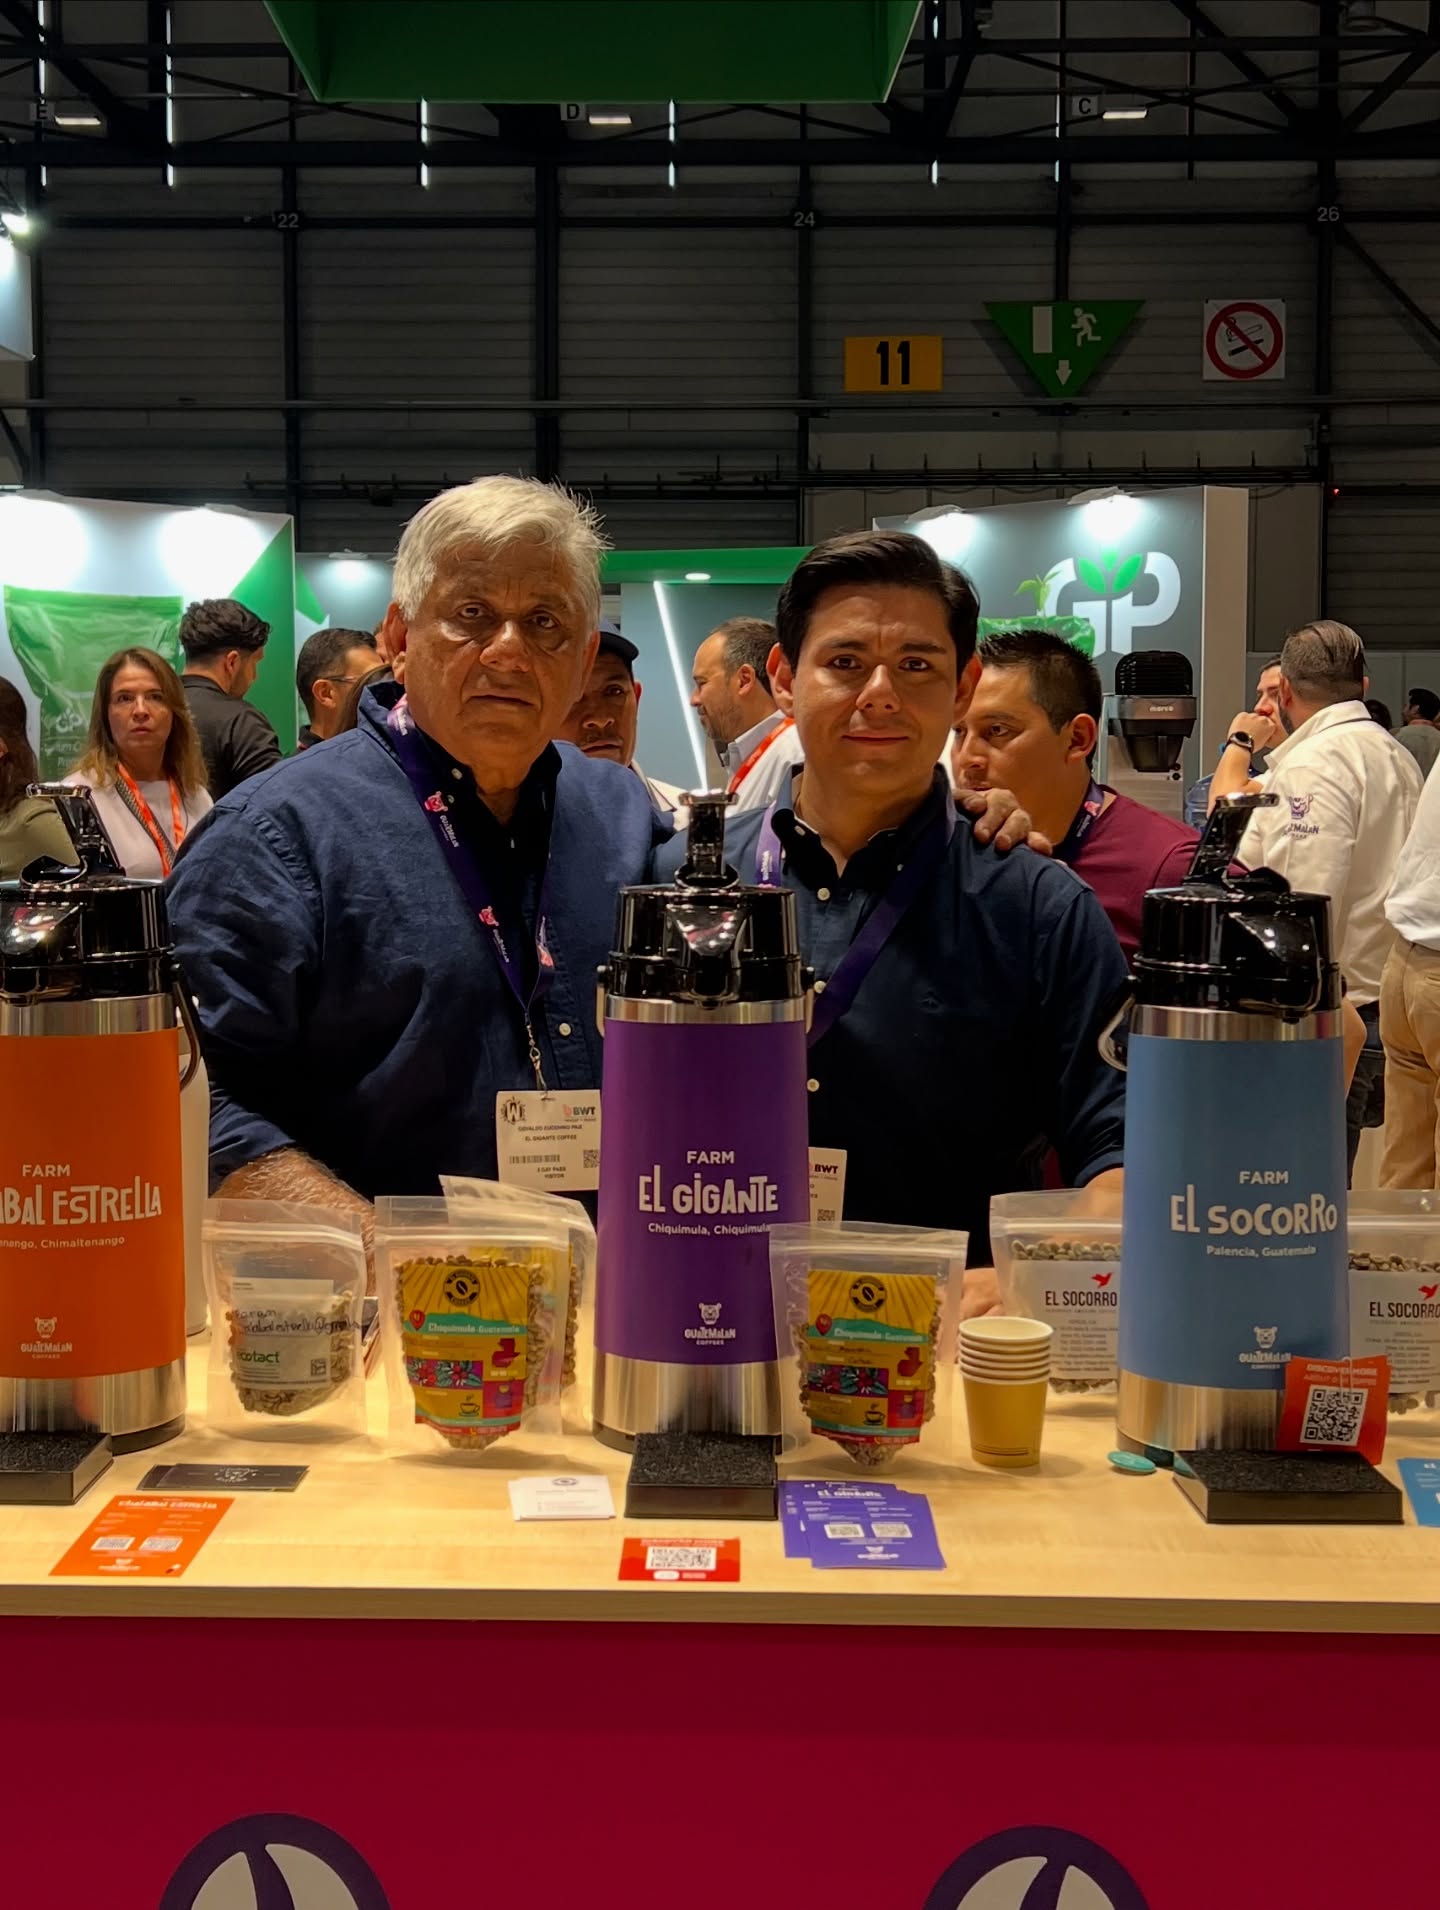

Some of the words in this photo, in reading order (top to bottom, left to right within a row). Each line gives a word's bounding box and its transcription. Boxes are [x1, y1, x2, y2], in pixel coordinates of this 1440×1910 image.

[566, 104, 580, 119] D
[1078, 98, 1092, 115] C
[277, 213, 299, 228] 22
[794, 211, 816, 227] 24
[1317, 206, 1339, 222] 26
[876, 340, 911, 386] 11
[1044, 551, 1182, 659] GP
[573, 1106, 596, 1116] BWT
[685, 1150, 735, 1165] FARM
[22, 1164, 71, 1178] FARM
[814, 1164, 839, 1174] BWT
[1239, 1170, 1289, 1185] FARM
[638, 1164, 667, 1213] EL
[52, 1175, 163, 1225] ESTRELLA
[1170, 1183, 1201, 1233] EL
[1207, 1193, 1338, 1236] SOCORRO
[648, 1222, 711, 1236] Chiquimula,
[40, 1236, 126, 1250] Chimaltenango
[1206, 1245, 1260, 1258] Palencia,
[1262, 1245, 1317, 1257] Guatemala
[1045, 1291, 1060, 1306] EL
[1062, 1291, 1118, 1307] SOCORRO
[1369, 1301, 1384, 1317] EL
